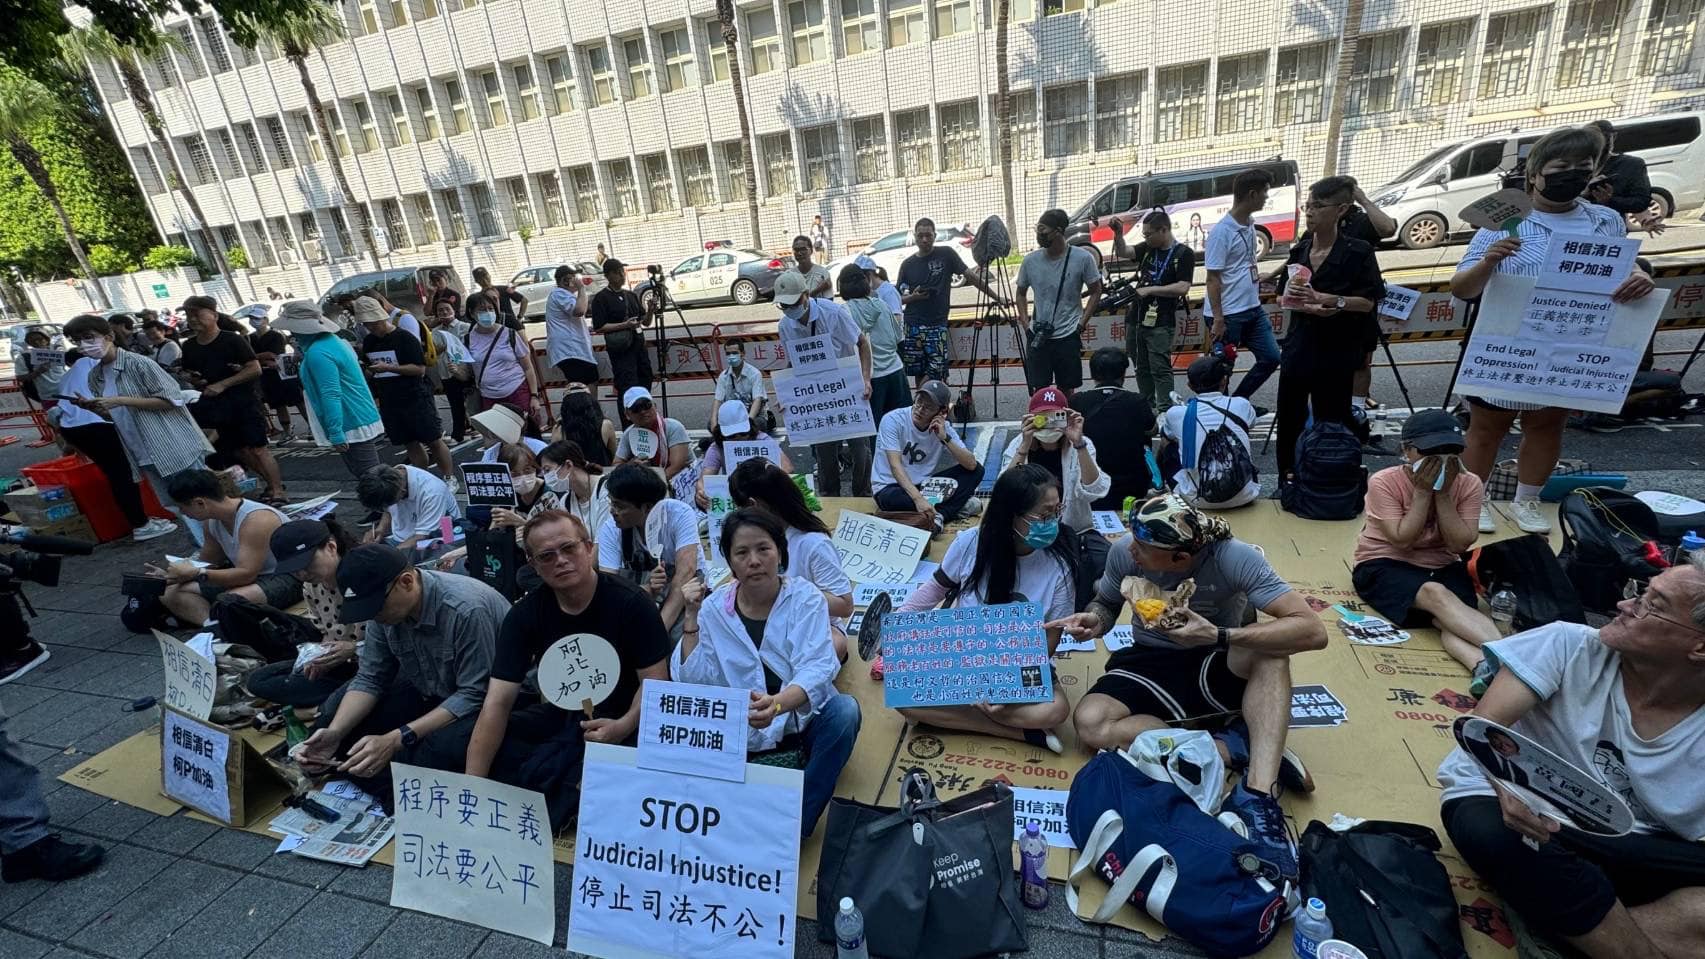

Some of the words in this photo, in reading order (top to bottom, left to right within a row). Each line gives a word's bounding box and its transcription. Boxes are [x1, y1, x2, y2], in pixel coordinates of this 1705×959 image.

[1562, 240, 1622, 260] 相信清白
[1558, 260, 1614, 278] 柯P加油
[1531, 296, 1567, 309] Justice
[1570, 299, 1612, 312] Denied!
[1485, 343, 1506, 354] End
[1508, 345, 1537, 358] Legal
[1576, 353, 1611, 365] STOP
[1474, 356, 1539, 371] Oppression!
[1550, 364, 1584, 376] Judicial
[1586, 368, 1629, 382] Injustice!
[793, 384, 815, 397] End
[817, 378, 846, 395] Legal
[789, 394, 857, 416] Oppression!
[734, 446, 769, 457] 相信清白
[465, 472, 511, 484] 程序要正義
[468, 485, 514, 498] 司法要公平
[838, 516, 920, 557] 相信清白
[659, 693, 728, 721] 相信清白
[172, 723, 214, 761] 相信清白
[658, 723, 724, 751] 柯P加油
[172, 755, 214, 791] 柯P加油
[943, 752, 1069, 781] 0800-222-222
[399, 778, 542, 846] 程序要正義
[639, 797, 722, 836] STOP
[402, 833, 540, 905] 司法要公平
[583, 836, 664, 872] Judicial
[670, 846, 782, 894] Injustice!
[933, 852, 960, 869] Keep
[936, 858, 982, 881] Promise
